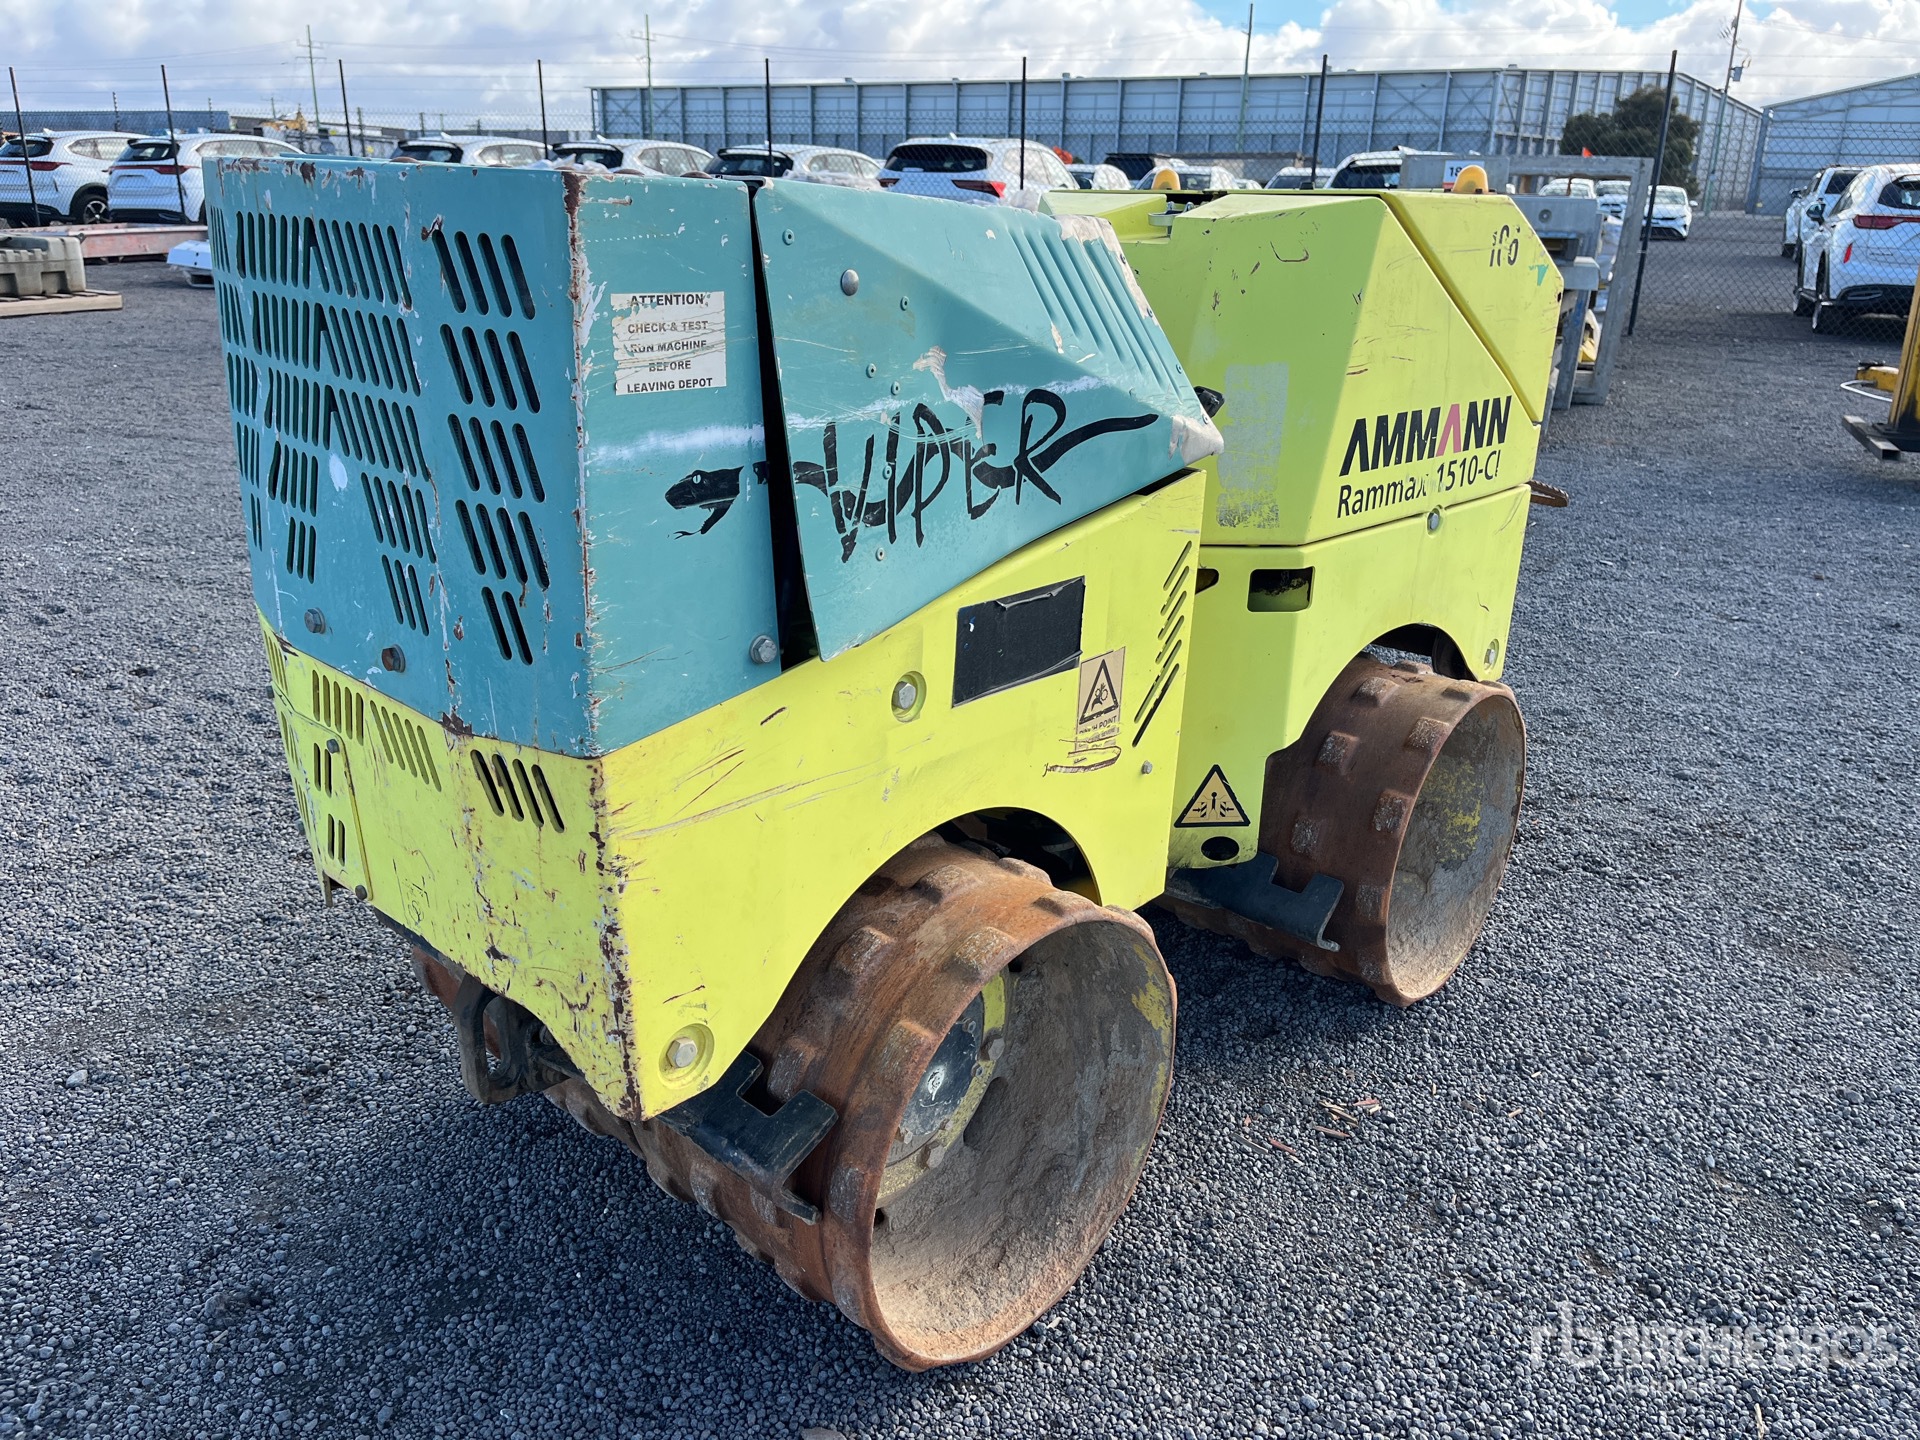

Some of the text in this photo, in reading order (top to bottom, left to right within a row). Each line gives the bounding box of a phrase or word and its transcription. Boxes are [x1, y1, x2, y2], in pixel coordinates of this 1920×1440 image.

[630, 293, 704, 307] ATTENTION
[627, 320, 709, 334] CHECK & TEST
[657, 340, 707, 352] MACHINE
[648, 360, 692, 372] BEFORE
[627, 377, 713, 393] LEAVING DEPOT
[1338, 395, 1513, 477] AMMANN
[823, 389, 1067, 563] VIPER
[1337, 473, 1428, 519] Rammax
